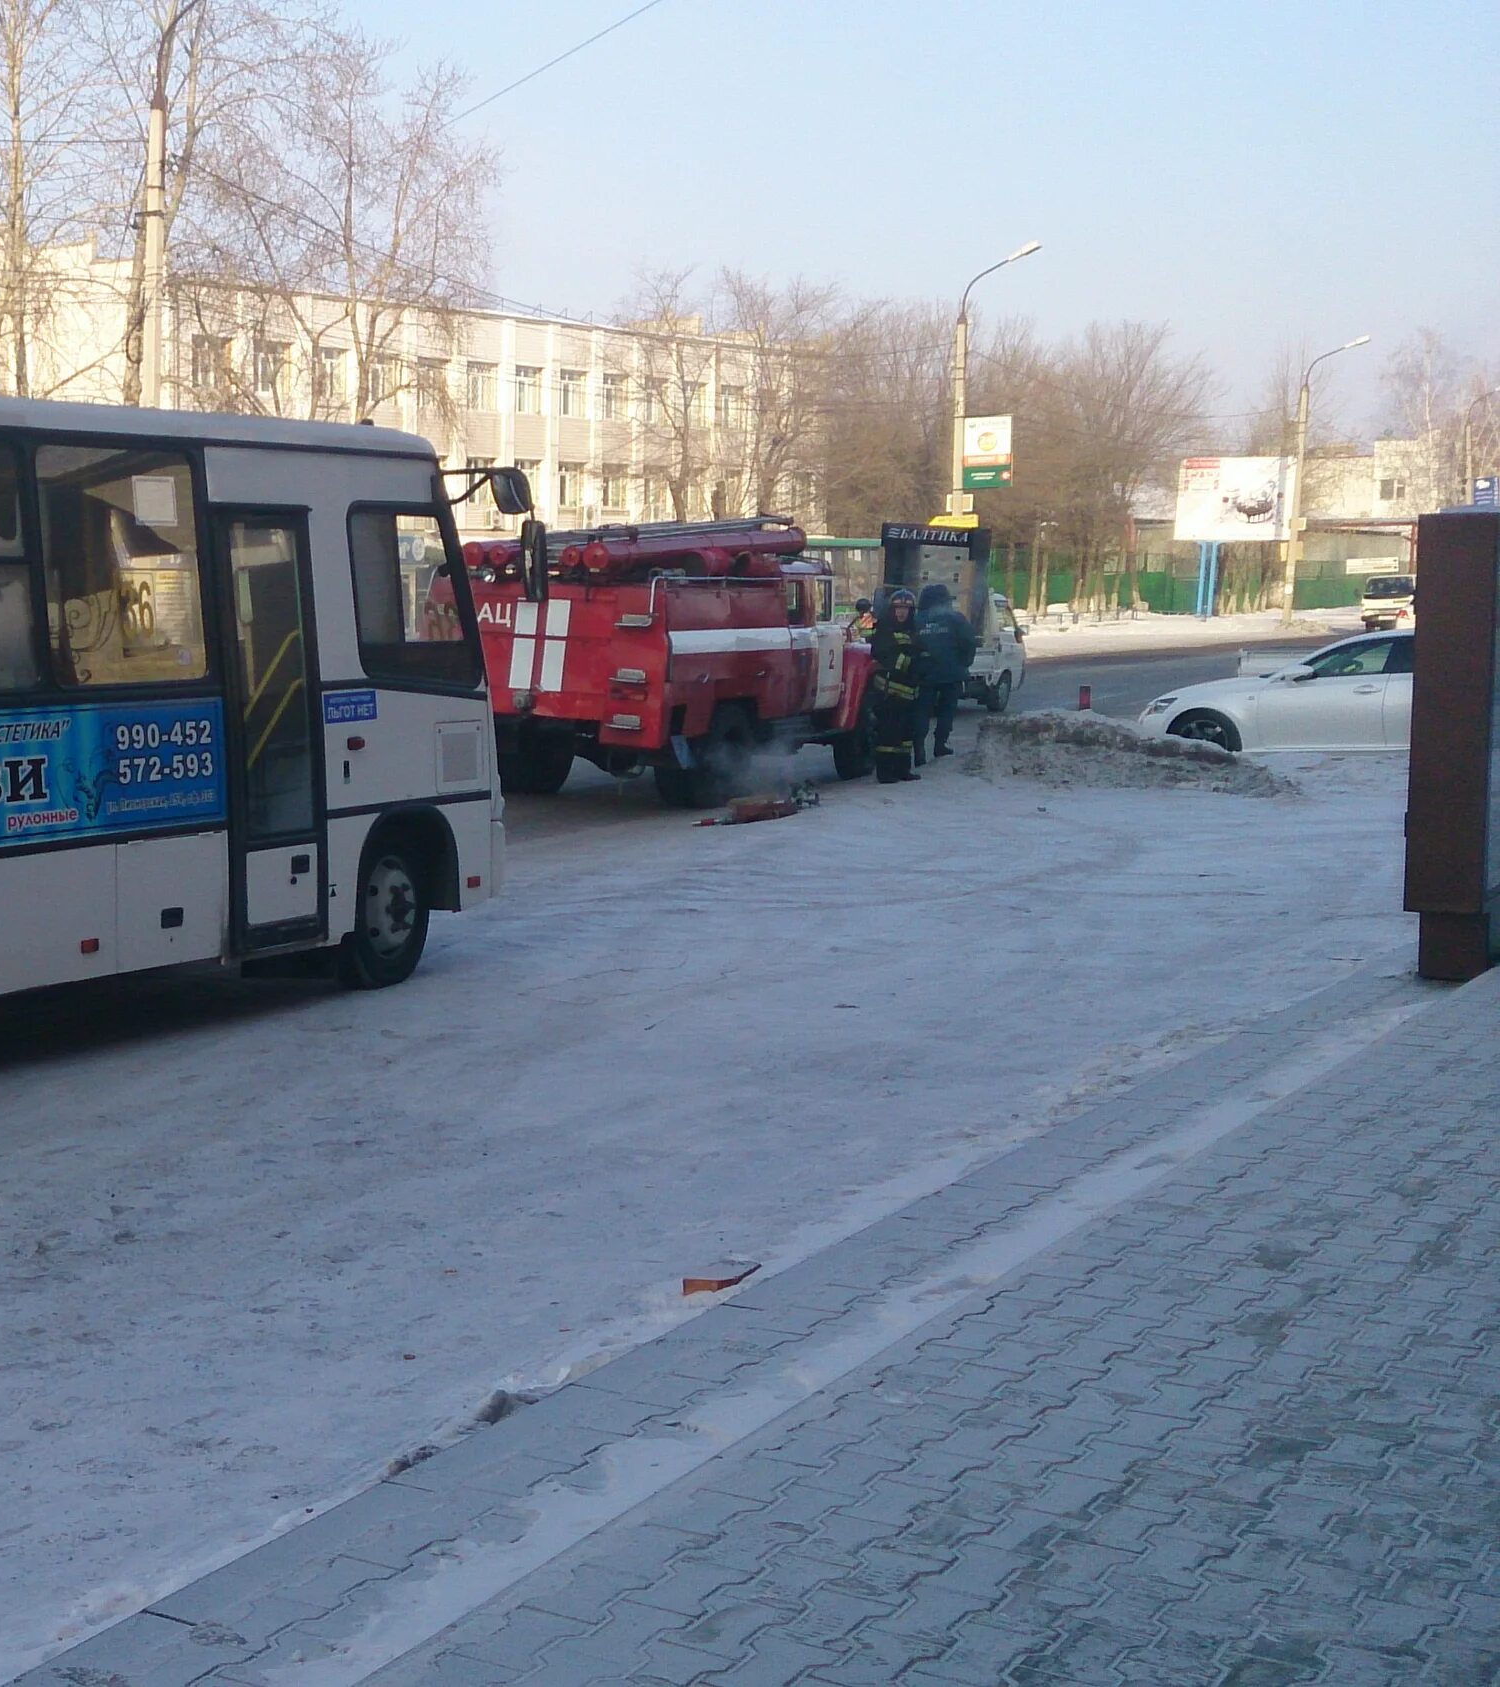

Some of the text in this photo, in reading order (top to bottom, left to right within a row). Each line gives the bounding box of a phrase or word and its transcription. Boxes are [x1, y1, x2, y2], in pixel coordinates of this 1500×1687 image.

[900, 528, 969, 542] БАЛТИКА
[478, 602, 511, 628] АЦ
[828, 648, 835, 670] 2
[357, 703, 374, 716] НЕТ
[116, 720, 212, 751] 990-452
[118, 752, 213, 784] 572-593
[7, 808, 79, 831] рулонные
